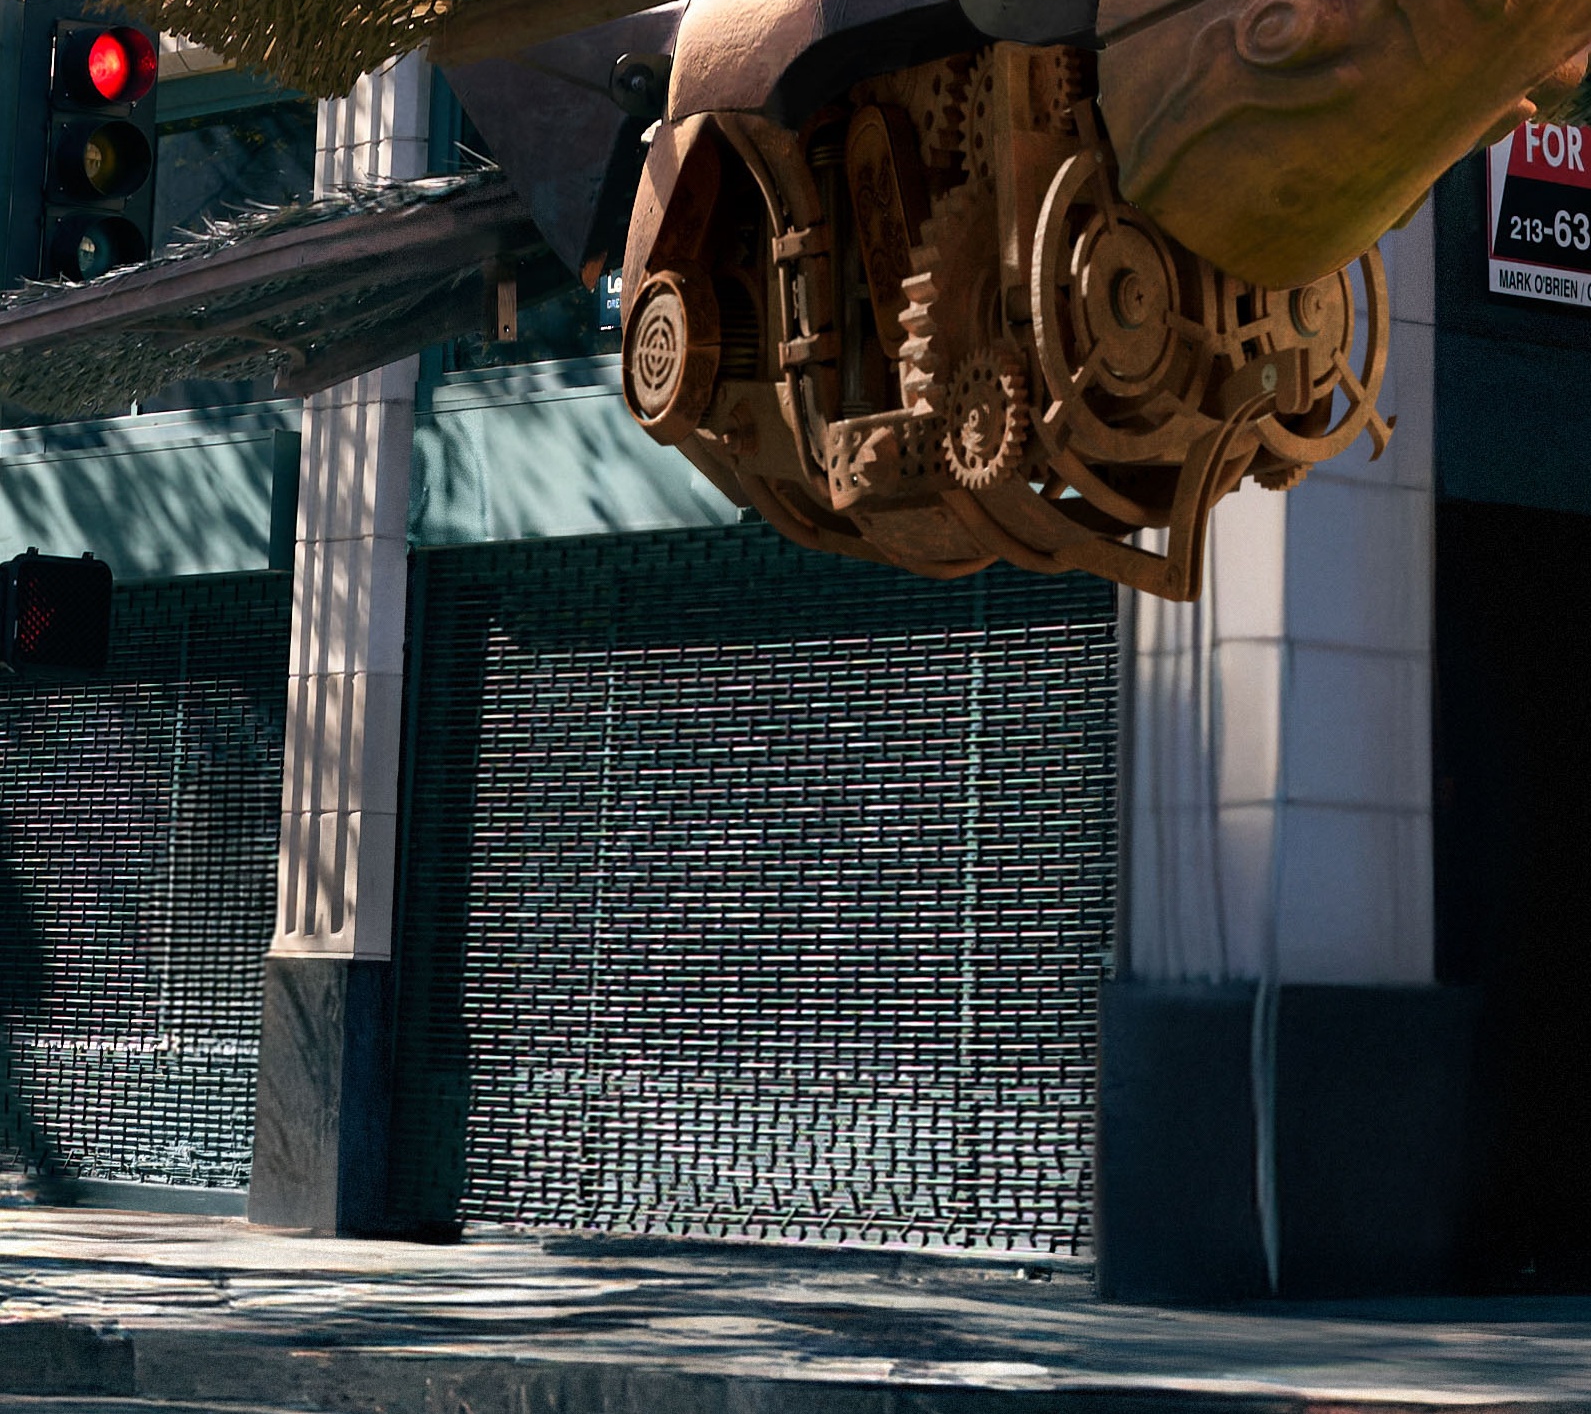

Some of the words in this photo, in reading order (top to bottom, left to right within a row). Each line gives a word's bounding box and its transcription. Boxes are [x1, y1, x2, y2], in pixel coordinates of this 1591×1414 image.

[1525, 122, 1585, 172] FOR
[1499, 269, 1532, 292] MARK
[1534, 275, 1578, 299] O'BRIEN
